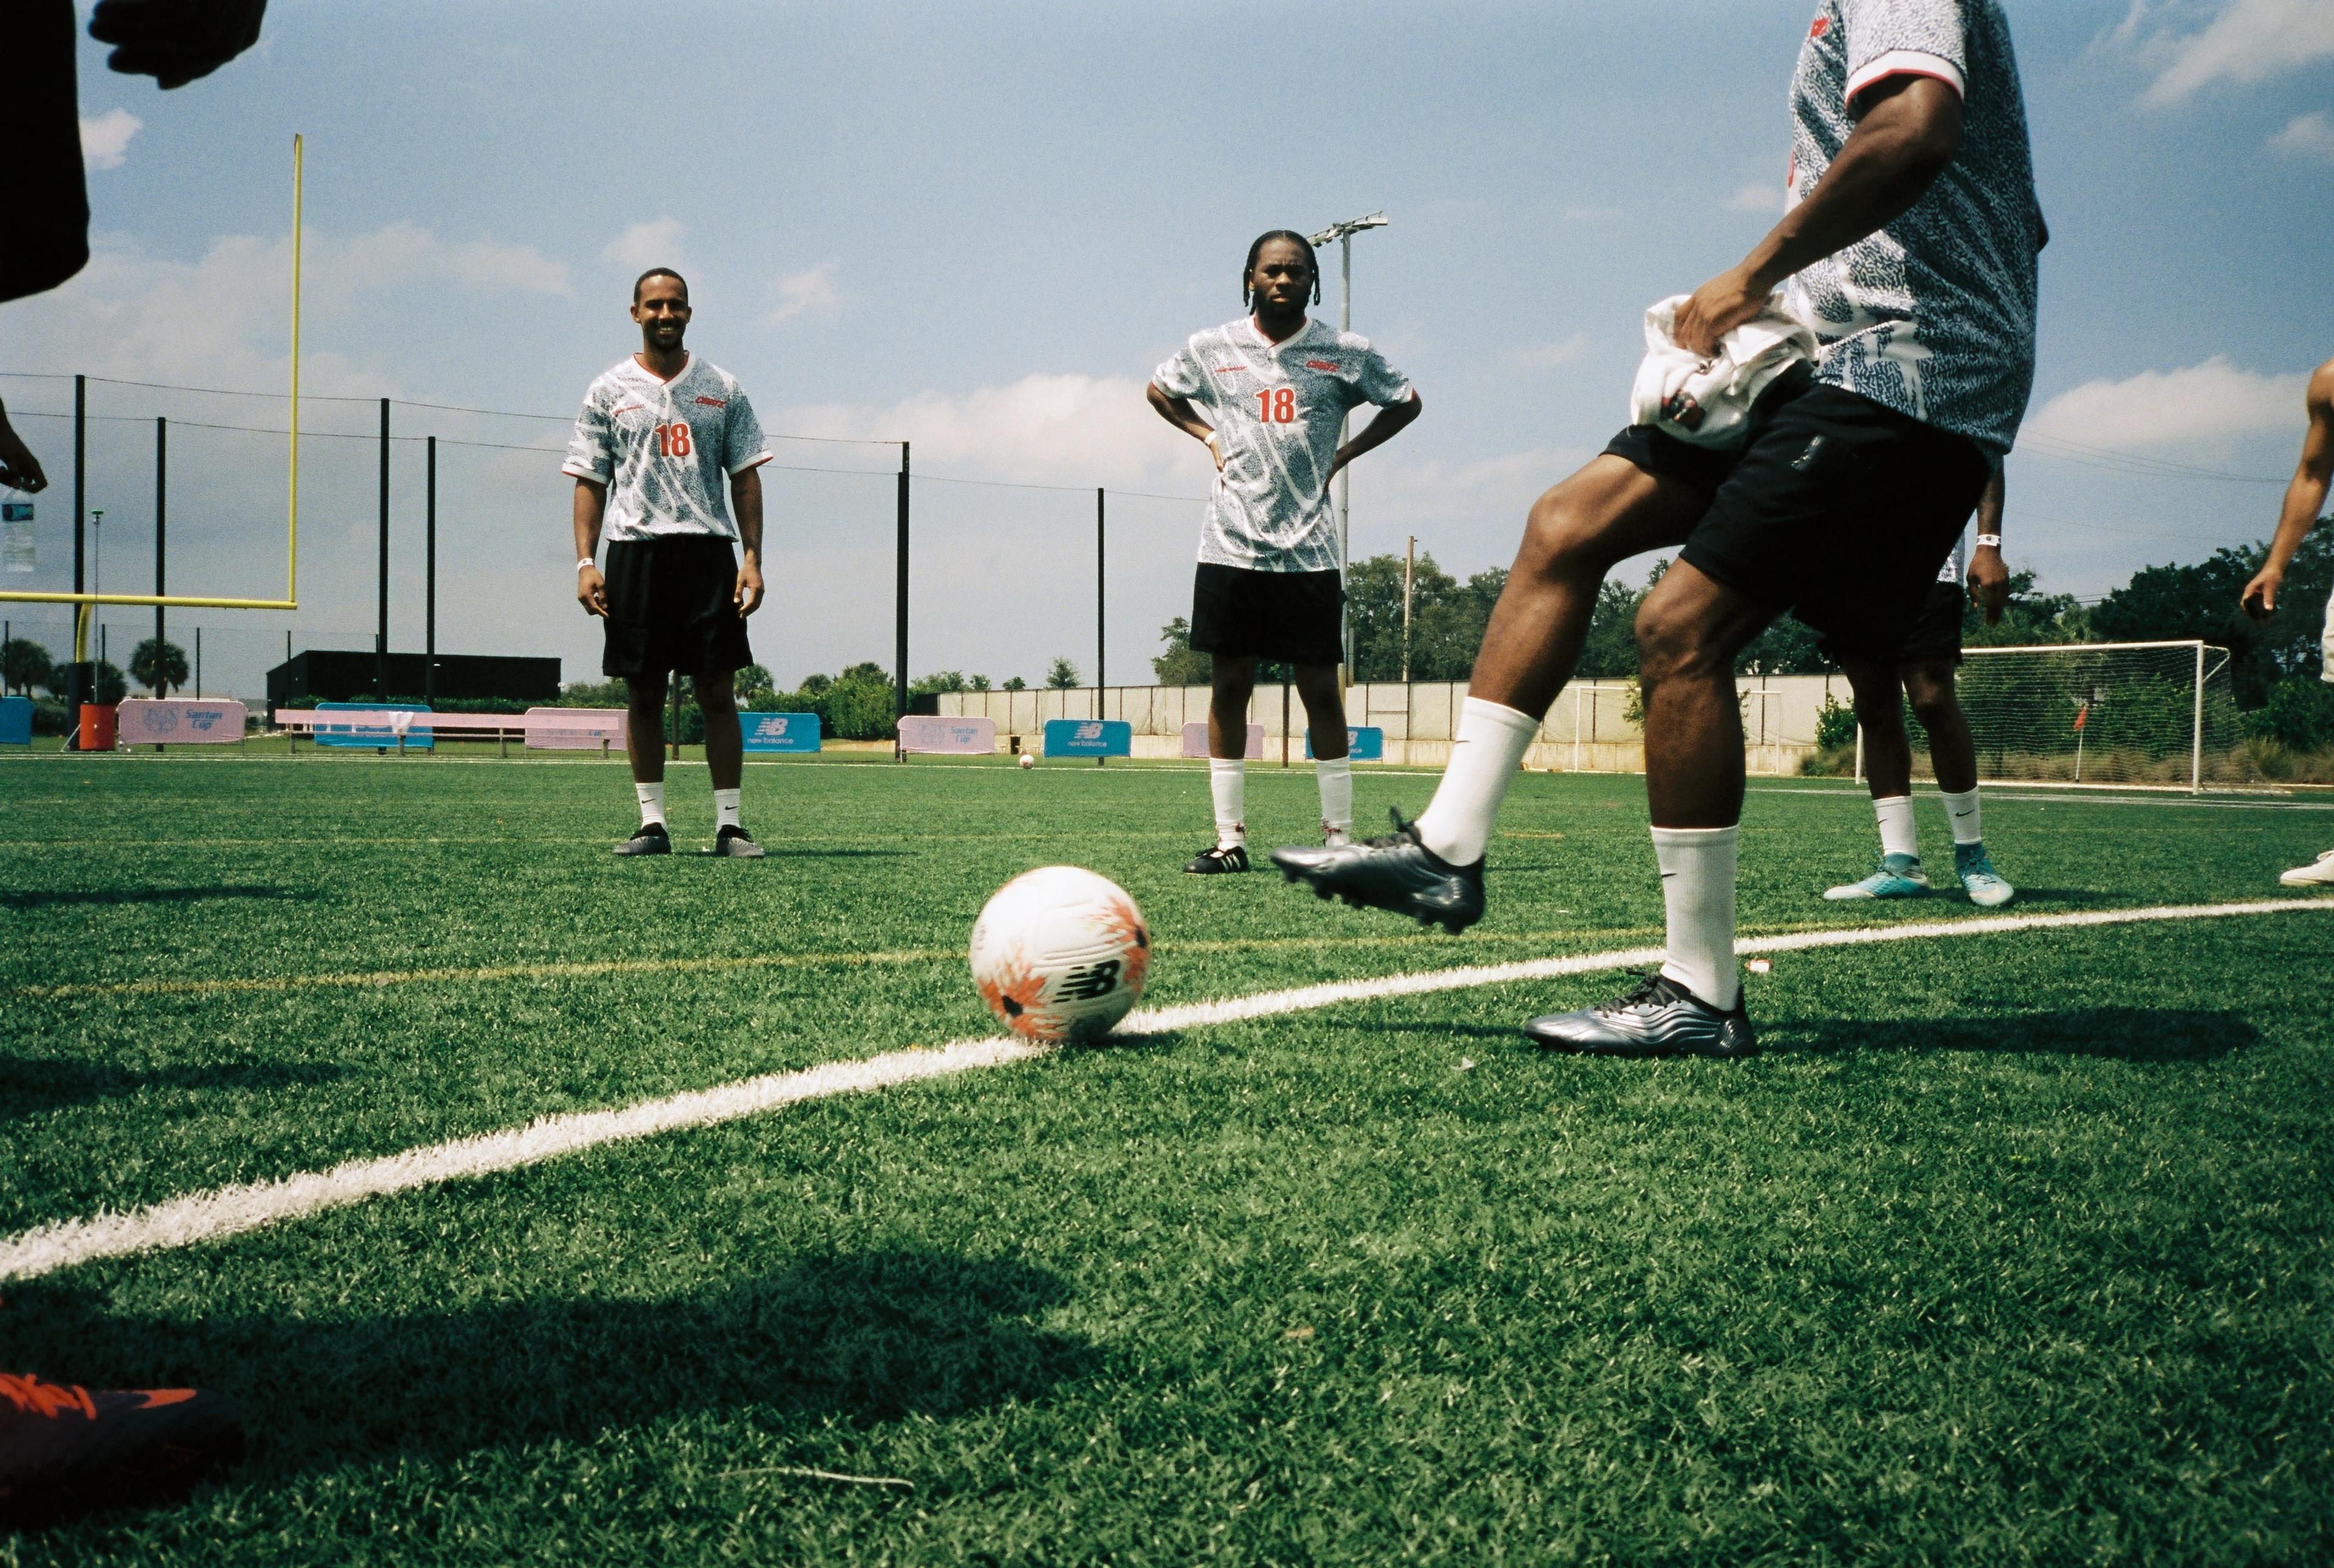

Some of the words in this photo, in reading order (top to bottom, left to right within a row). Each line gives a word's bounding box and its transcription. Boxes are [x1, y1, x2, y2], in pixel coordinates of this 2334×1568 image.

[1255, 387, 1296, 425] 18
[654, 422, 690, 458] 18
[192, 720, 212, 731] Cup
